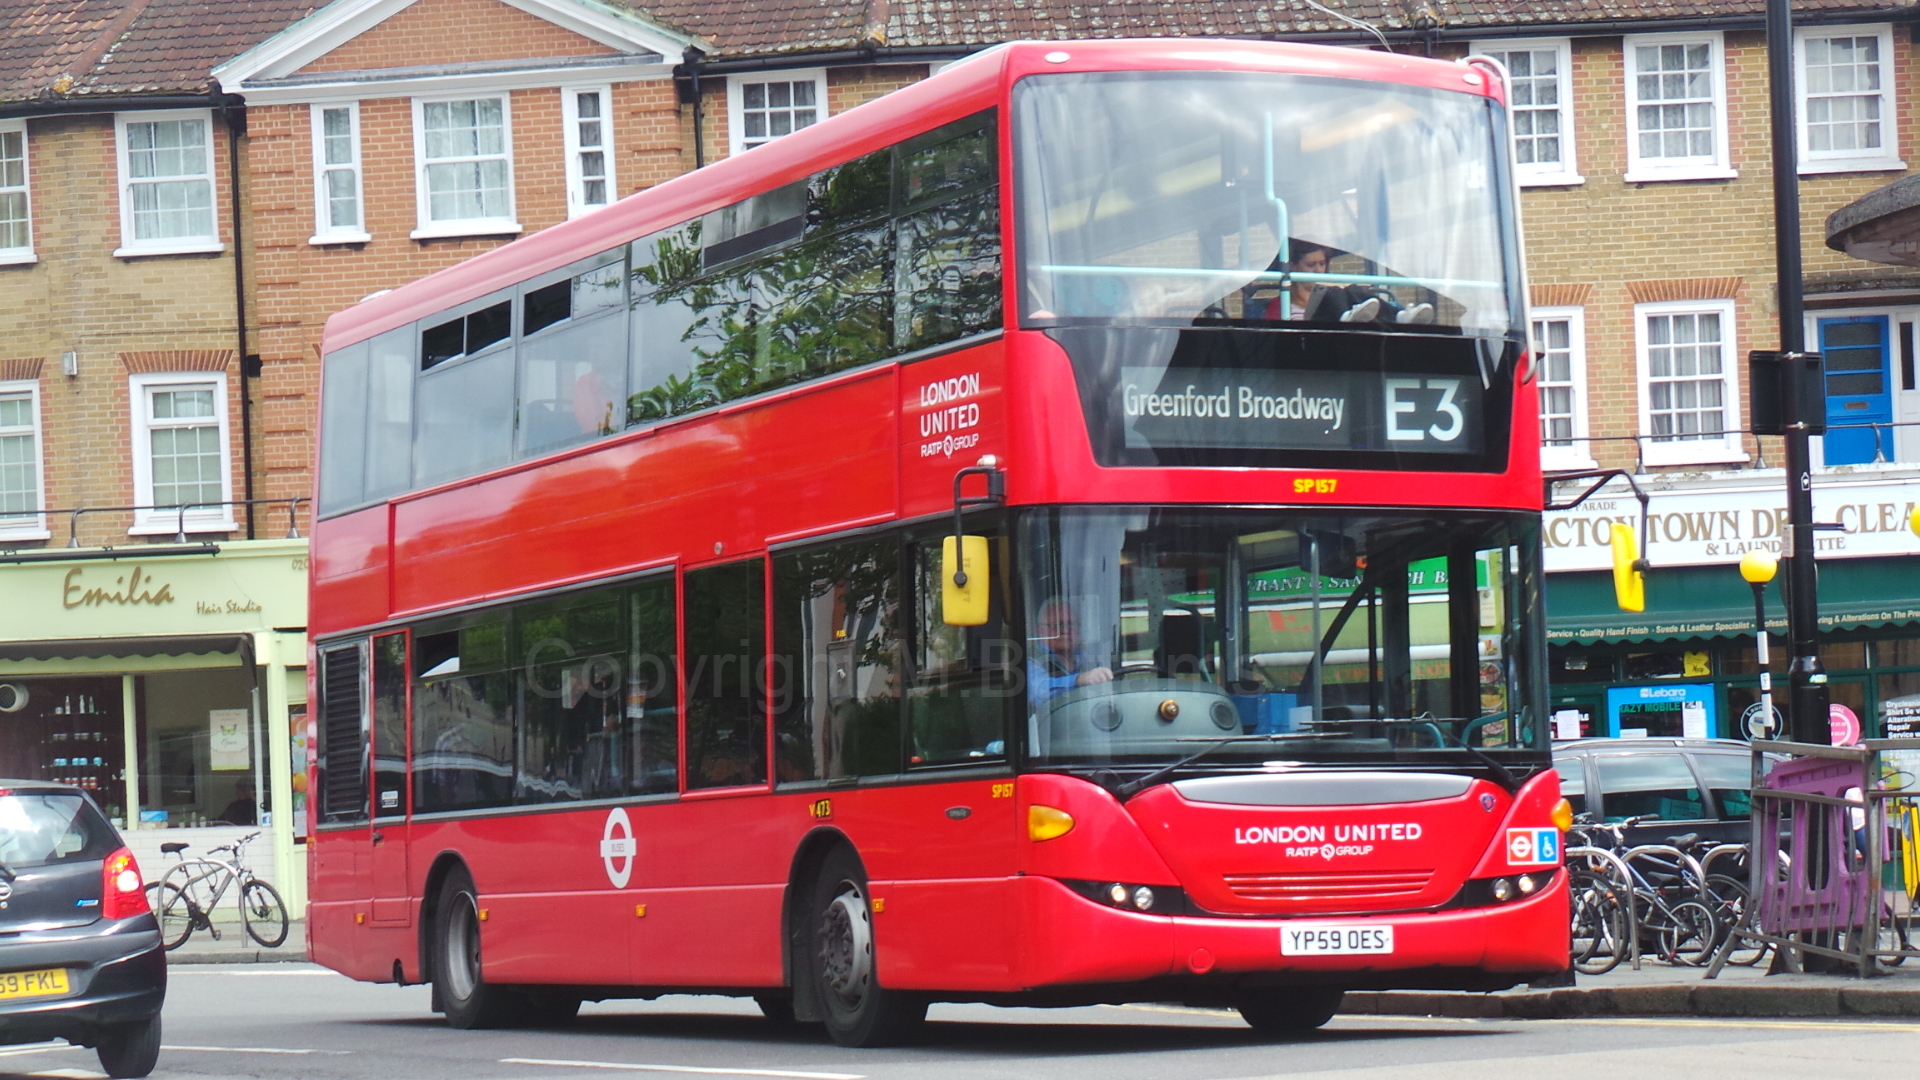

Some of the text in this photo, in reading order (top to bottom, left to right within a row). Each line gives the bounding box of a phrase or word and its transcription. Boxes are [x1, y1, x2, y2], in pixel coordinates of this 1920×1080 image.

[920, 372, 980, 407] LONDON
[1124, 384, 1344, 430] Greenford Broadway
[1386, 378, 1465, 441] E3
[920, 403, 980, 437] UNITED
[920, 433, 979, 457] RATP GROUP
[1293, 479, 1337, 493] SP157
[1575, 501, 1617, 512] PARADE
[1647, 510, 1741, 544] TOWN
[1705, 542, 1719, 556] &
[63, 566, 175, 609] Emilia
[196, 599, 262, 615] Hair Studio
[1546, 629, 1574, 639] Service
[1579, 629, 1605, 638] Quality
[1606, 627, 1625, 637] Hand
[1626, 626, 1649, 636] Finish
[1655, 624, 1678, 634] Suede
[1687, 622, 1714, 632] Leather
[1715, 621, 1750, 632] Specialist
[1841, 612, 1880, 622] Alterations
[1880, 611, 1892, 620] On
[1893, 610, 1907, 619] The
[1649, 687, 1687, 698] Lebara
[1644, 702, 1681, 712] MOBILE
[992, 784, 1014, 798] SP157
[815, 800, 831, 818] 473
[1235, 823, 1422, 844] LONDON UNITED
[1286, 845, 1374, 857] RATP GROUP
[1291, 930, 1384, 950] YP59 OES
[24, 971, 63, 992] FKL
